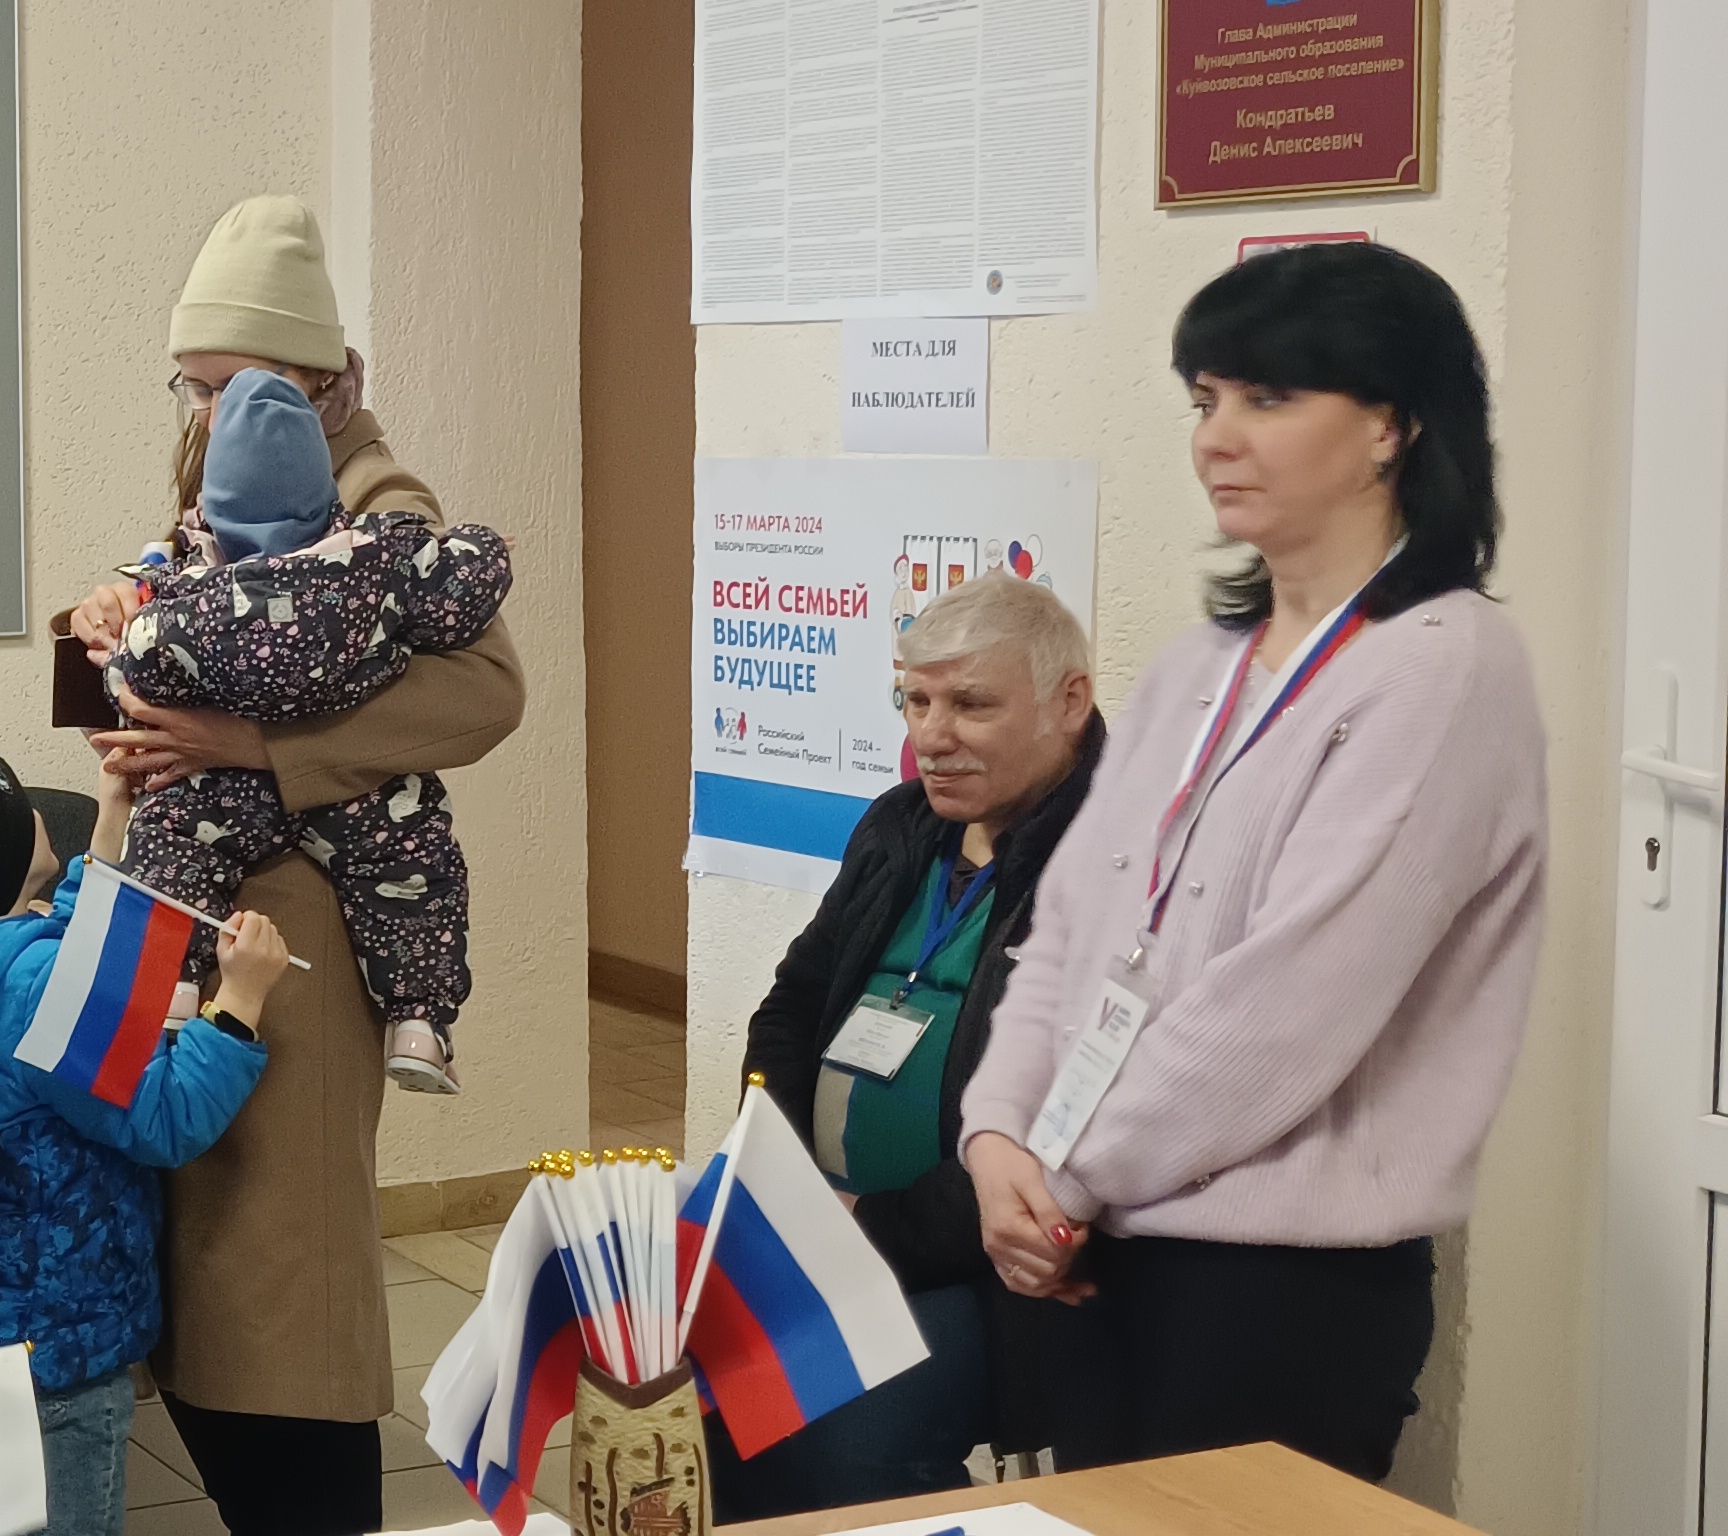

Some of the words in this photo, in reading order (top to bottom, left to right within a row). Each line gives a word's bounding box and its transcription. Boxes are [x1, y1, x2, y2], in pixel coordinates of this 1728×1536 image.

[1217, 28, 1253, 45] Глава
[1256, 12, 1358, 40] Администрации
[1194, 45, 1297, 73] Муниципального
[1299, 33, 1384, 59] образования
[1176, 73, 1264, 99] «Куйвозовское
[1266, 68, 1325, 87] сельское
[1327, 58, 1405, 80] поселение»
[1236, 104, 1335, 131] Кондратьев
[1208, 140, 1258, 166] Денис
[1262, 132, 1364, 157] Алексеевич
[871, 340, 922, 358] МЕСТА
[925, 339, 957, 360] ДЛЯ
[851, 386, 976, 409] НАБЛЮДАТЕЛЕЙ
[714, 513, 743, 531] 15-17
[746, 514, 791, 532] МАРТА
[794, 515, 823, 534] 2024
[714, 540, 744, 552] ВЫБОРЫ
[713, 575, 770, 611] ВСЕЙ
[778, 582, 868, 619] СЕМЬЕЙ
[713, 617, 837, 656] ВЫБИРАЕМ
[713, 654, 817, 696] БУДУЩЕЕ
[757, 742, 800, 759] Семейный
[801, 749, 832, 765] Проект
[852, 738, 874, 753] 2024
